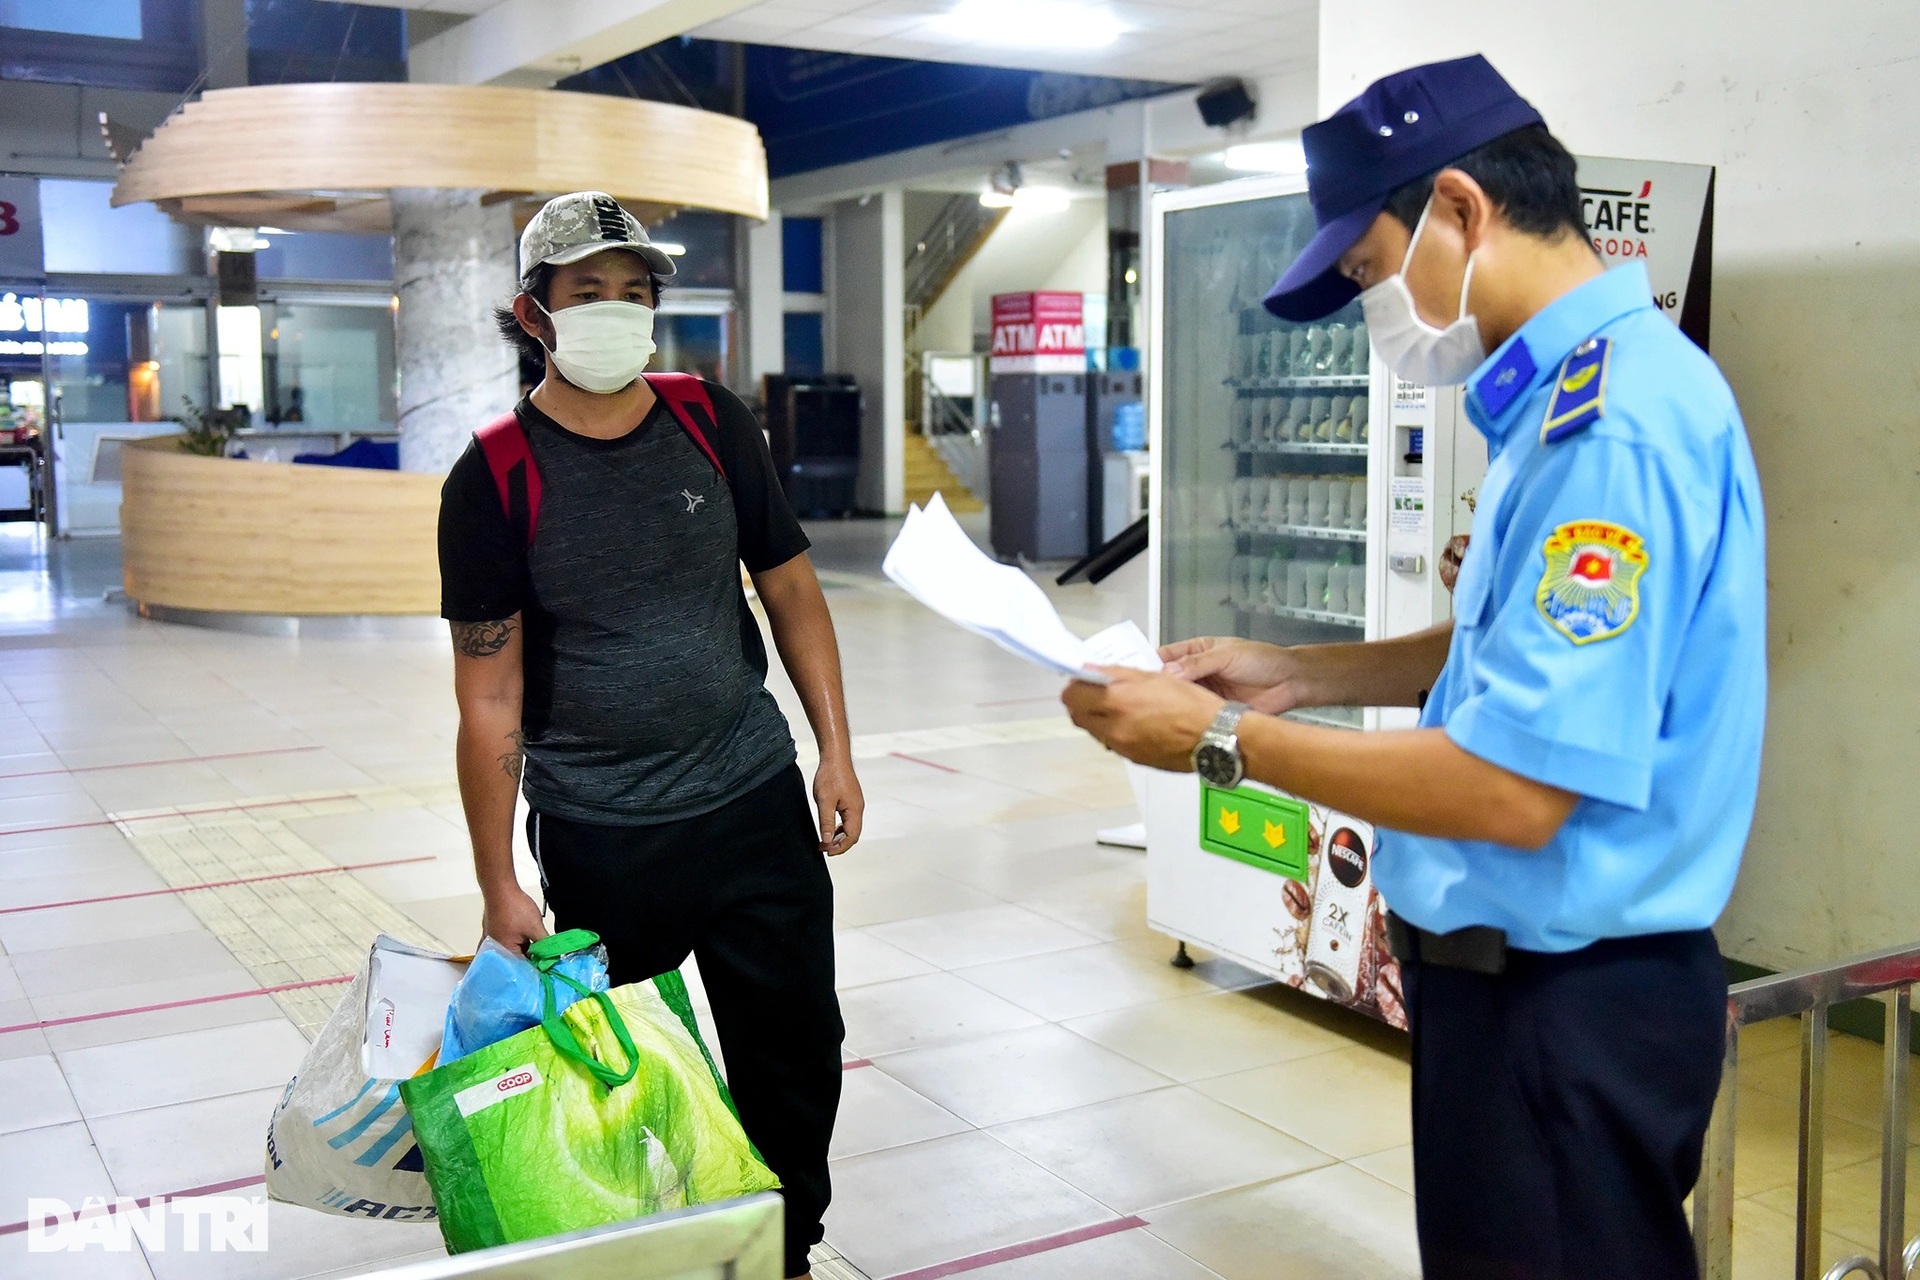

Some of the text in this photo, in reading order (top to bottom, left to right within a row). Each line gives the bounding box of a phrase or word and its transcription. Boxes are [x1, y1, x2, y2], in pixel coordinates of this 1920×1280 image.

[592, 198, 629, 243] NIKE
[1593, 238, 1648, 257] SODA
[992, 323, 1035, 353] ATM
[1038, 323, 1084, 351] ATM
[1329, 902, 1348, 927] 2X
[498, 1072, 531, 1091] COOP
